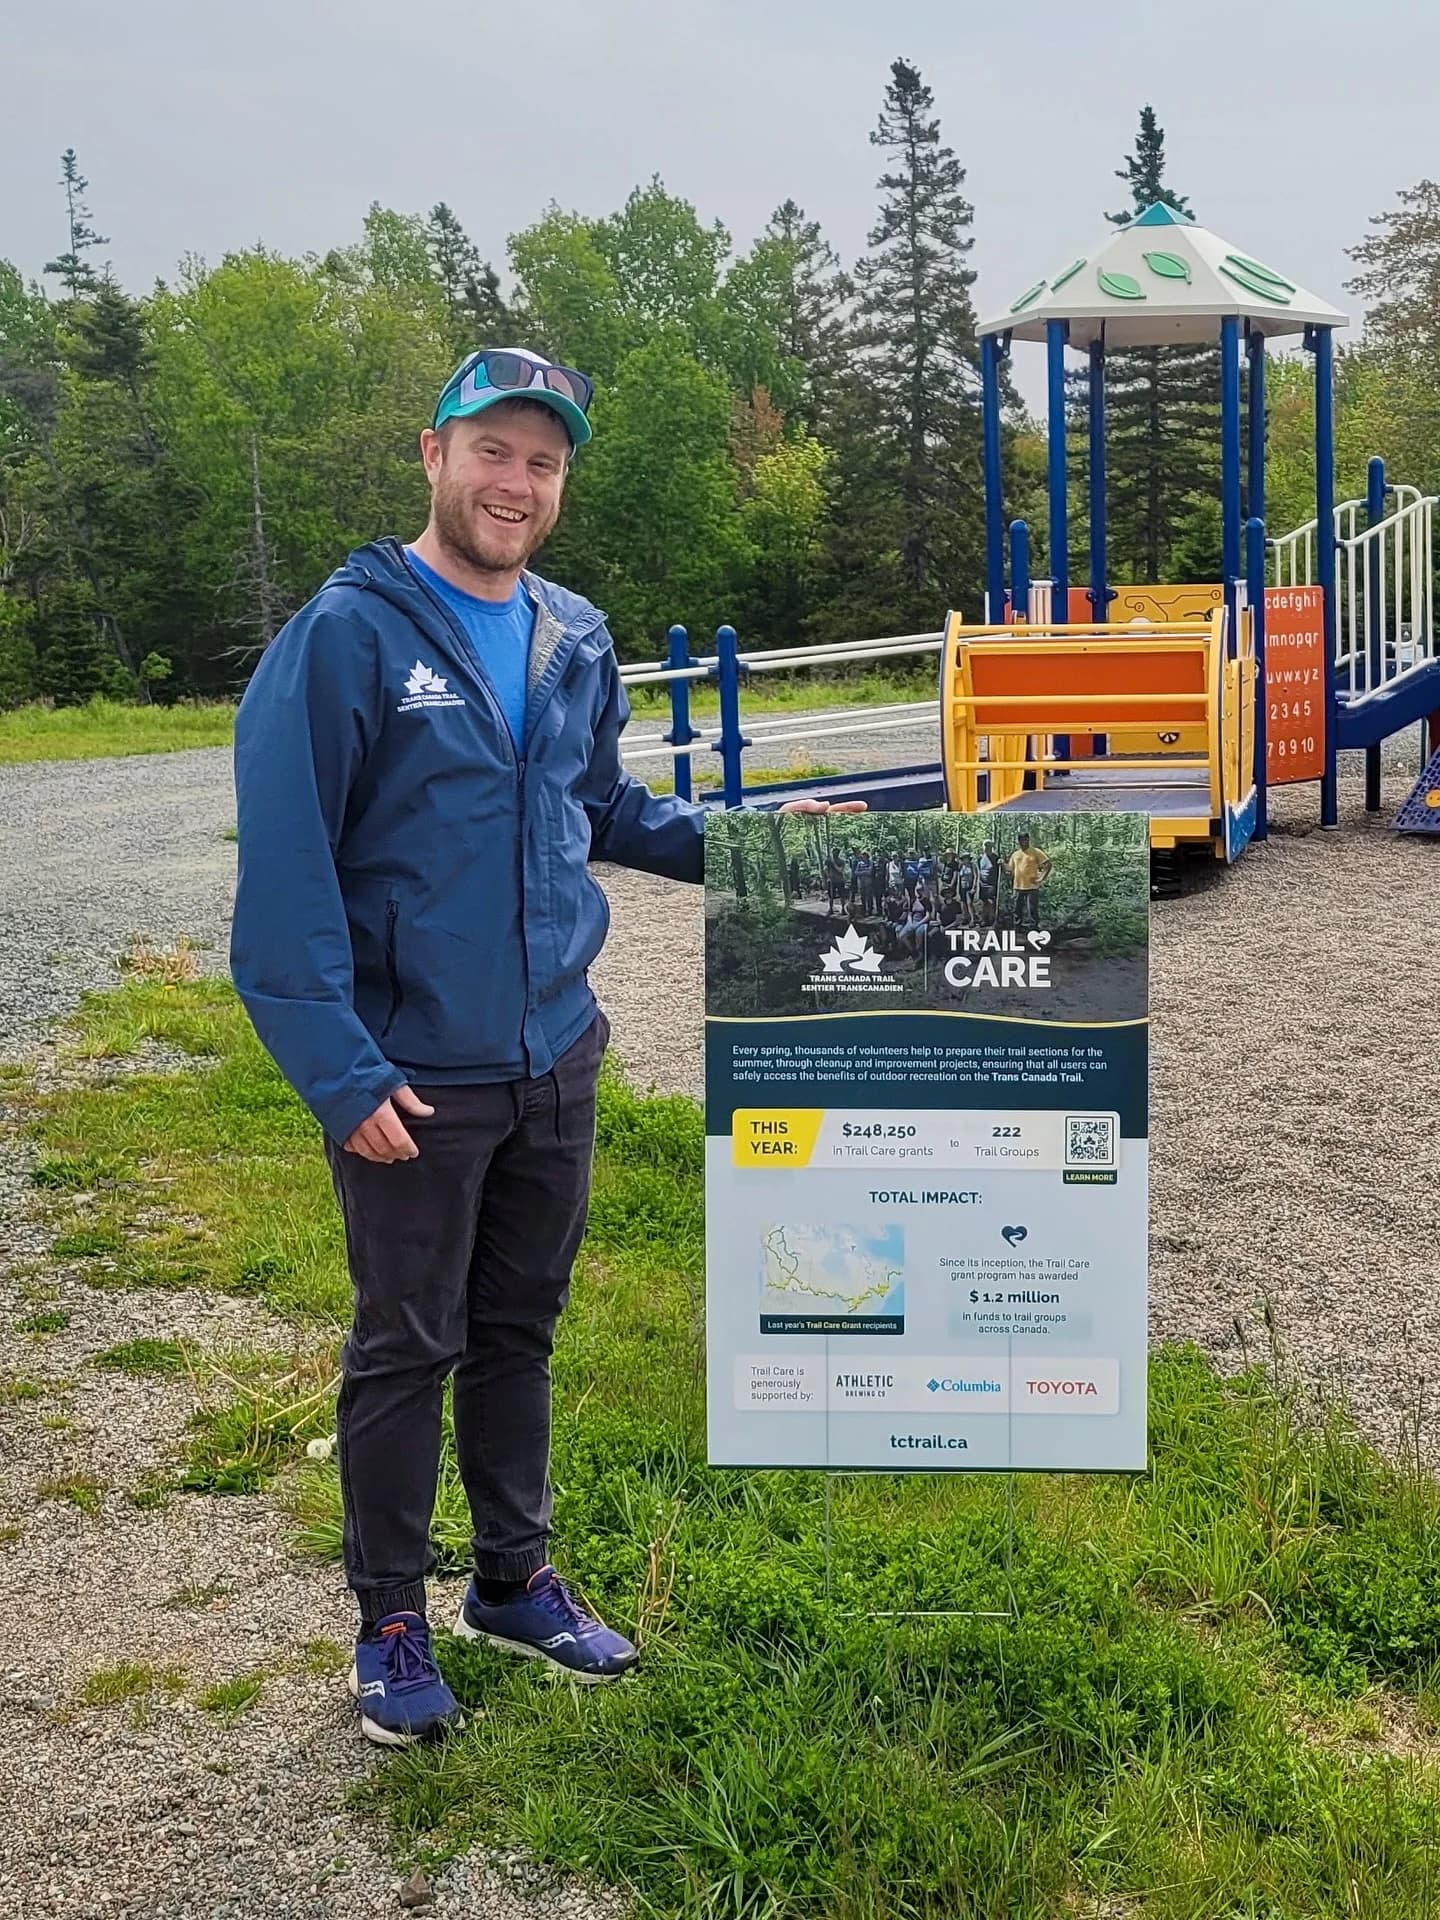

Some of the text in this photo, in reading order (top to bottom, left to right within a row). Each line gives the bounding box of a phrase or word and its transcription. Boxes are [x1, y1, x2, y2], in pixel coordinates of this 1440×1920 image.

[944, 930, 1025, 952] TRAIL
[809, 974, 896, 982] TRANS CANADA TRAIL
[944, 956, 1052, 988] CARE
[801, 984, 904, 992] SENTIER TRANSCANADIEN
[732, 1045, 1102, 1058] Every spring, thousands of volunteers help to prepare their trail sections for the
[732, 1058, 1108, 1070] summer, through cleanup and improvement projects, ensuring that all users can
[732, 1071, 762, 1082] safely
[764, 1072, 797, 1080] access
[800, 1071, 814, 1080] the
[816, 1071, 856, 1080] benefits
[857, 1071, 868, 1080] of
[870, 1072, 907, 1080] outdoor
[909, 1072, 957, 1081] recreation
[974, 1072, 990, 1081] the
[991, 1072, 1018, 1082] Trans
[1021, 1072, 1058, 1082] Canada
[1059, 1072, 1084, 1082] Trail.
[750, 1121, 788, 1134] THIS
[842, 1122, 916, 1138] $248,250
[992, 1126, 1022, 1138] 222
[750, 1141, 798, 1154] YEAR:
[950, 1139, 960, 1148] to
[833, 1145, 934, 1158] in Trail Care grants
[974, 1146, 1040, 1158] Trail Groups
[1066, 1174, 1114, 1182] LEARN MORE
[869, 1191, 982, 1204] TOTAL IMPACT:
[939, 1258, 1090, 1269] Since its inception, the Trail Care
[950, 1271, 1078, 1282] grant program has awarded
[969, 1289, 1060, 1304] $ 1.2 million
[974, 1312, 1000, 1321] funds
[1002, 1312, 1012, 1321] to
[1014, 1312, 1032, 1321] trail
[1034, 1313, 1066, 1324] groups
[768, 1321, 897, 1331] Last year's Trail Care Grant recipients
[978, 1324, 1050, 1334] across Canada.
[751, 1366, 804, 1376] Trail Care is
[751, 1379, 801, 1390] generously
[836, 1374, 894, 1388] ATHLETIC
[941, 1378, 1001, 1392] Columbia
[845, 1390, 876, 1398] BREWING
[1026, 1381, 1098, 1395] TOYOTA
[751, 1391, 814, 1402] supported by:
[890, 1434, 968, 1450] tctrail.ca
